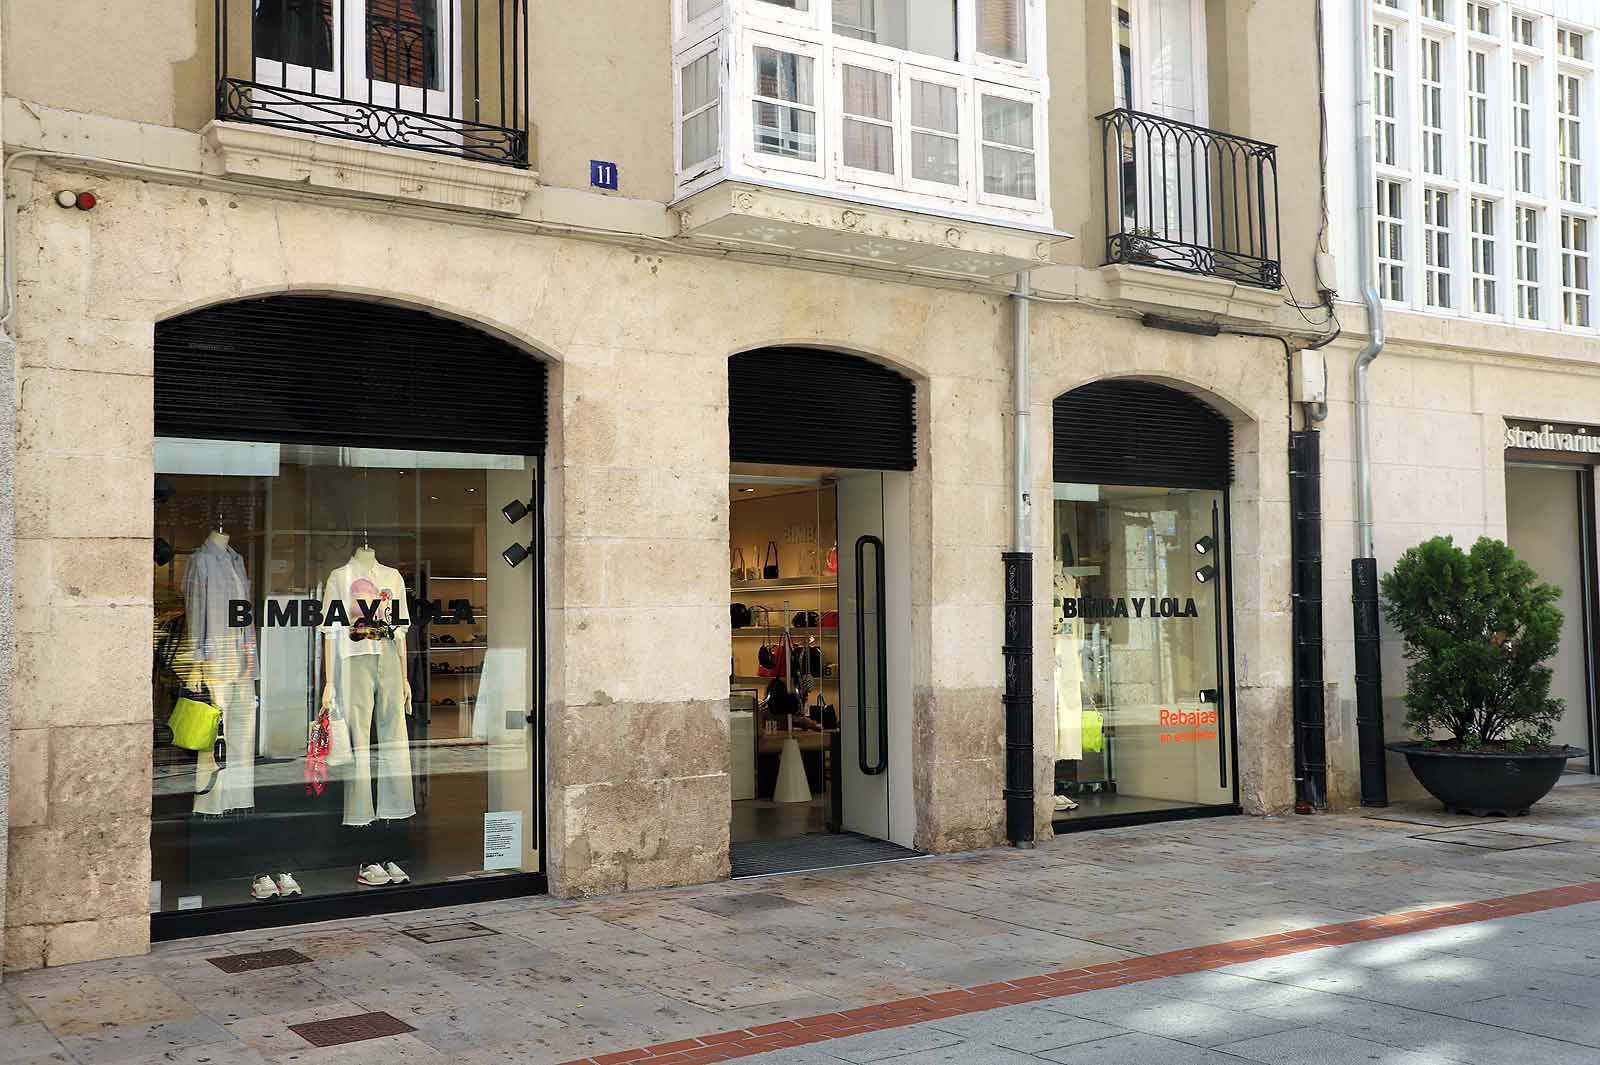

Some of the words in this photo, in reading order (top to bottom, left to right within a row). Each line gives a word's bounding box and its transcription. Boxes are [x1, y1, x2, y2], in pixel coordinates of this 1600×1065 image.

[597, 165, 611, 185] 11
[228, 599, 350, 628] BIMBA
[356, 599, 380, 626] Y
[391, 599, 477, 626] LOLA
[1063, 597, 1129, 618] BIMBA
[1131, 597, 1146, 618] Y
[1150, 597, 1199, 618] LOLA
[1159, 708, 1217, 729] Rebajas
